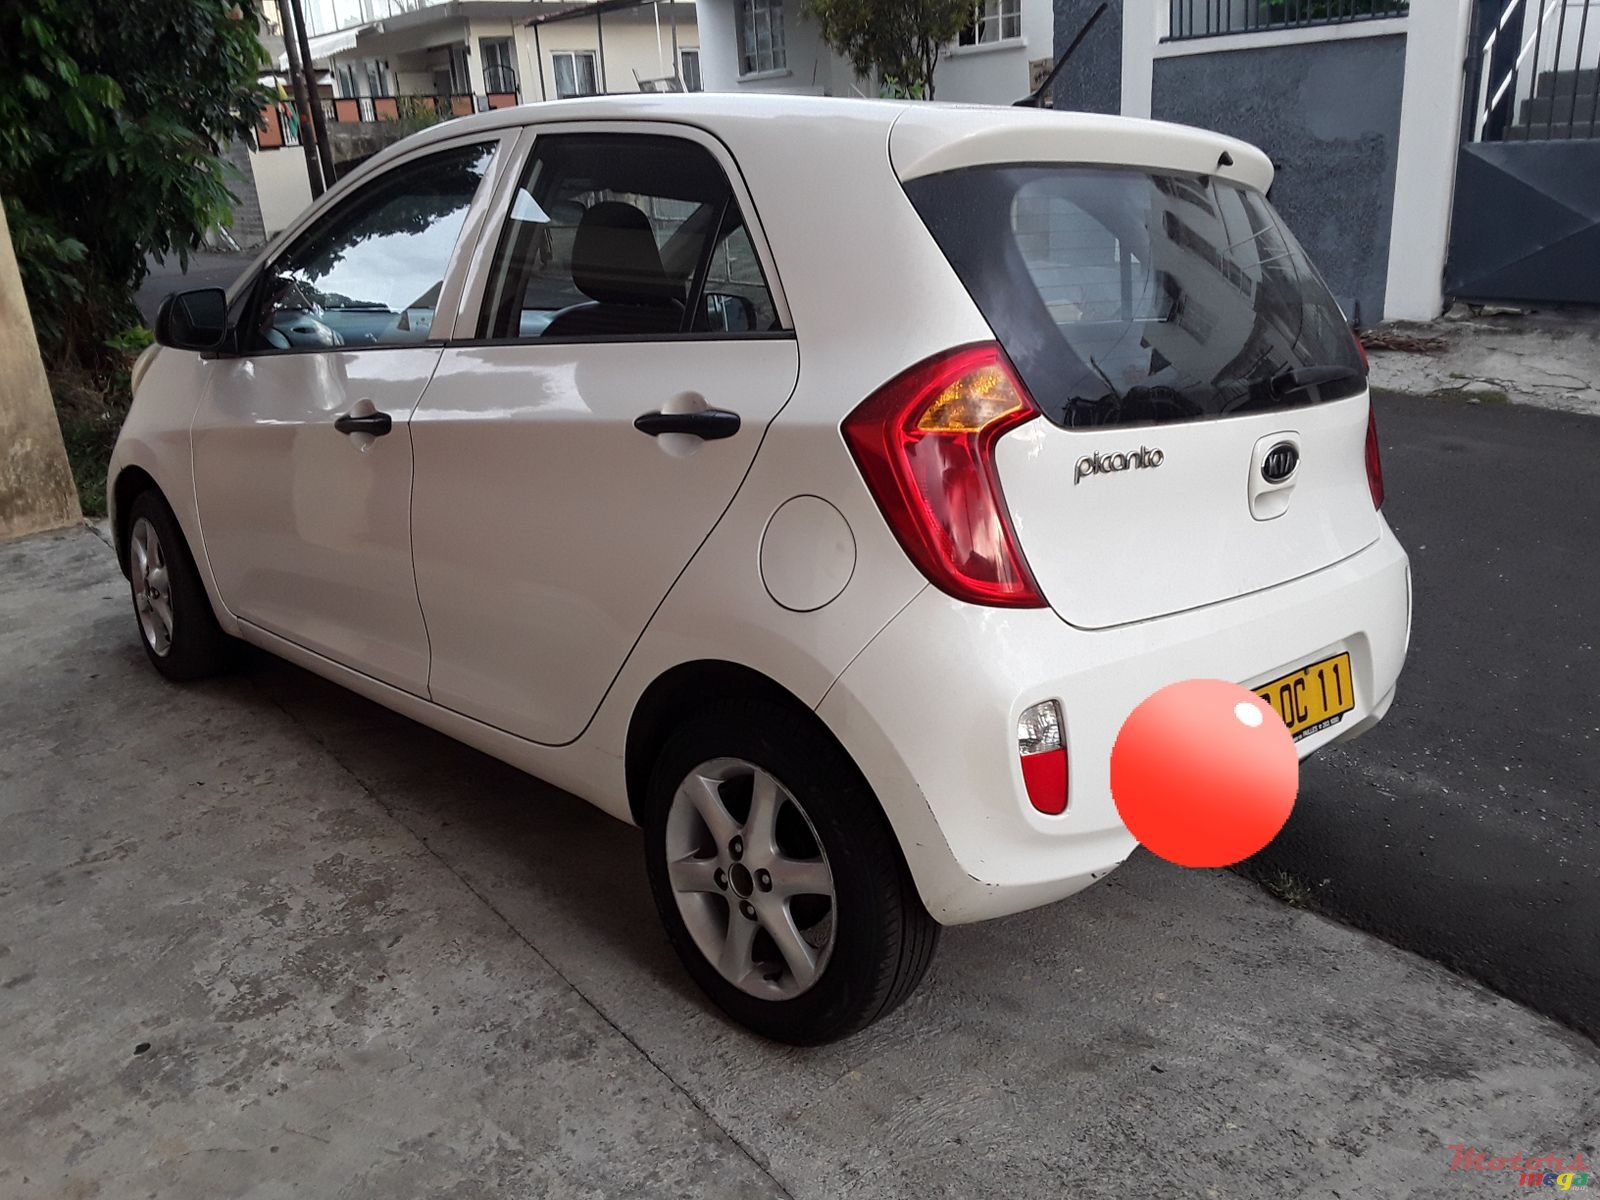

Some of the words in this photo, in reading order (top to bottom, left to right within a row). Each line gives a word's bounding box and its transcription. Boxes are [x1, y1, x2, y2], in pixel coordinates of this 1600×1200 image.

[1074, 444, 1164, 485] picanto
[1267, 450, 1295, 476] KIA
[1318, 663, 1343, 712] 11
